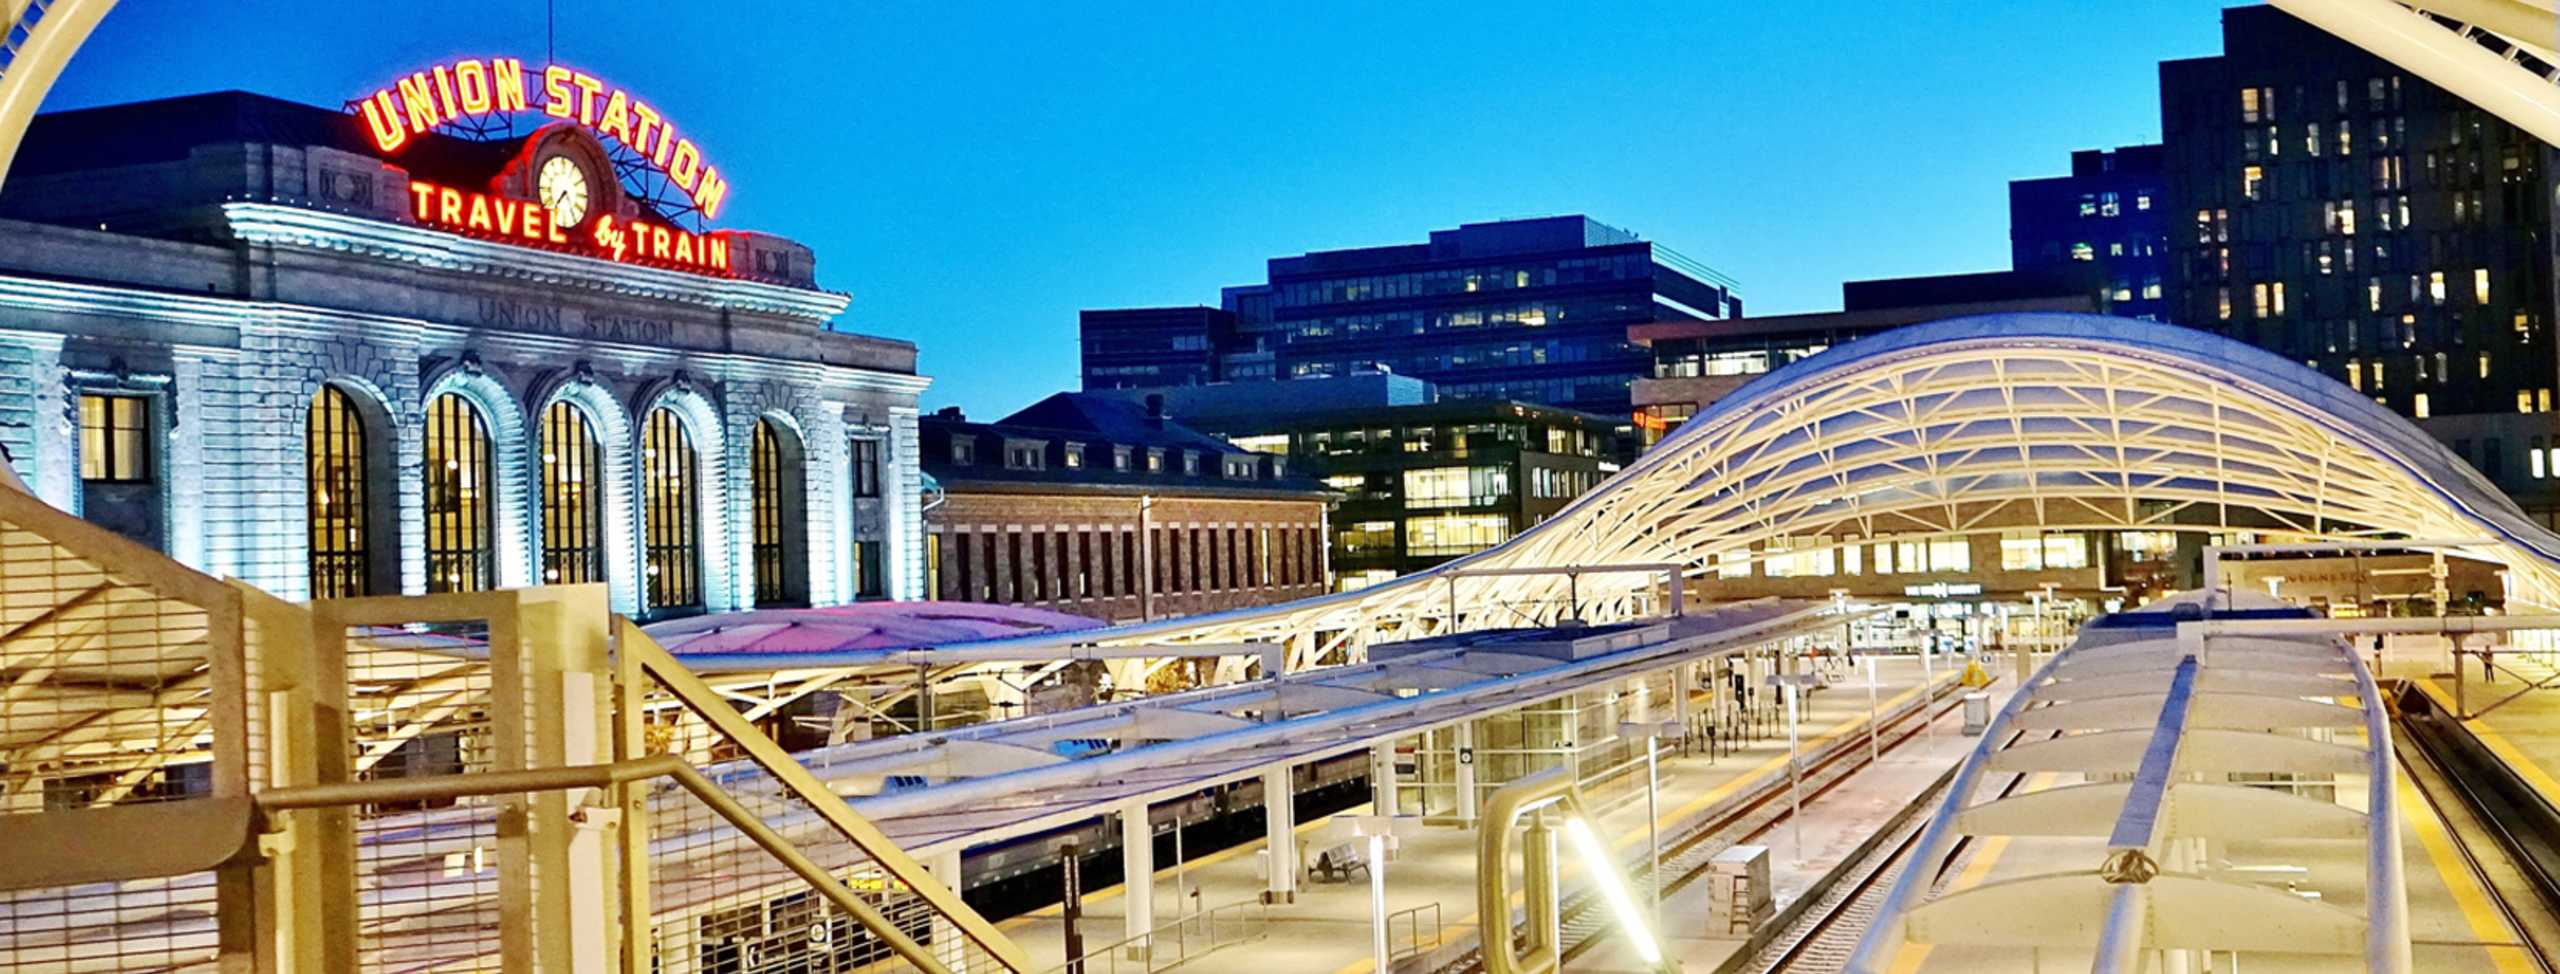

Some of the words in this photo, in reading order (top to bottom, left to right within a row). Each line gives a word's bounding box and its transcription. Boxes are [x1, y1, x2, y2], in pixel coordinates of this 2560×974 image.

[362, 58, 526, 152] UNION
[544, 65, 729, 219] STATION
[411, 182, 567, 243] TRAVEL
[594, 213, 626, 261] by
[631, 222, 729, 269] TRAIN
[478, 298, 561, 332] UNION
[583, 311, 674, 345] STATION
